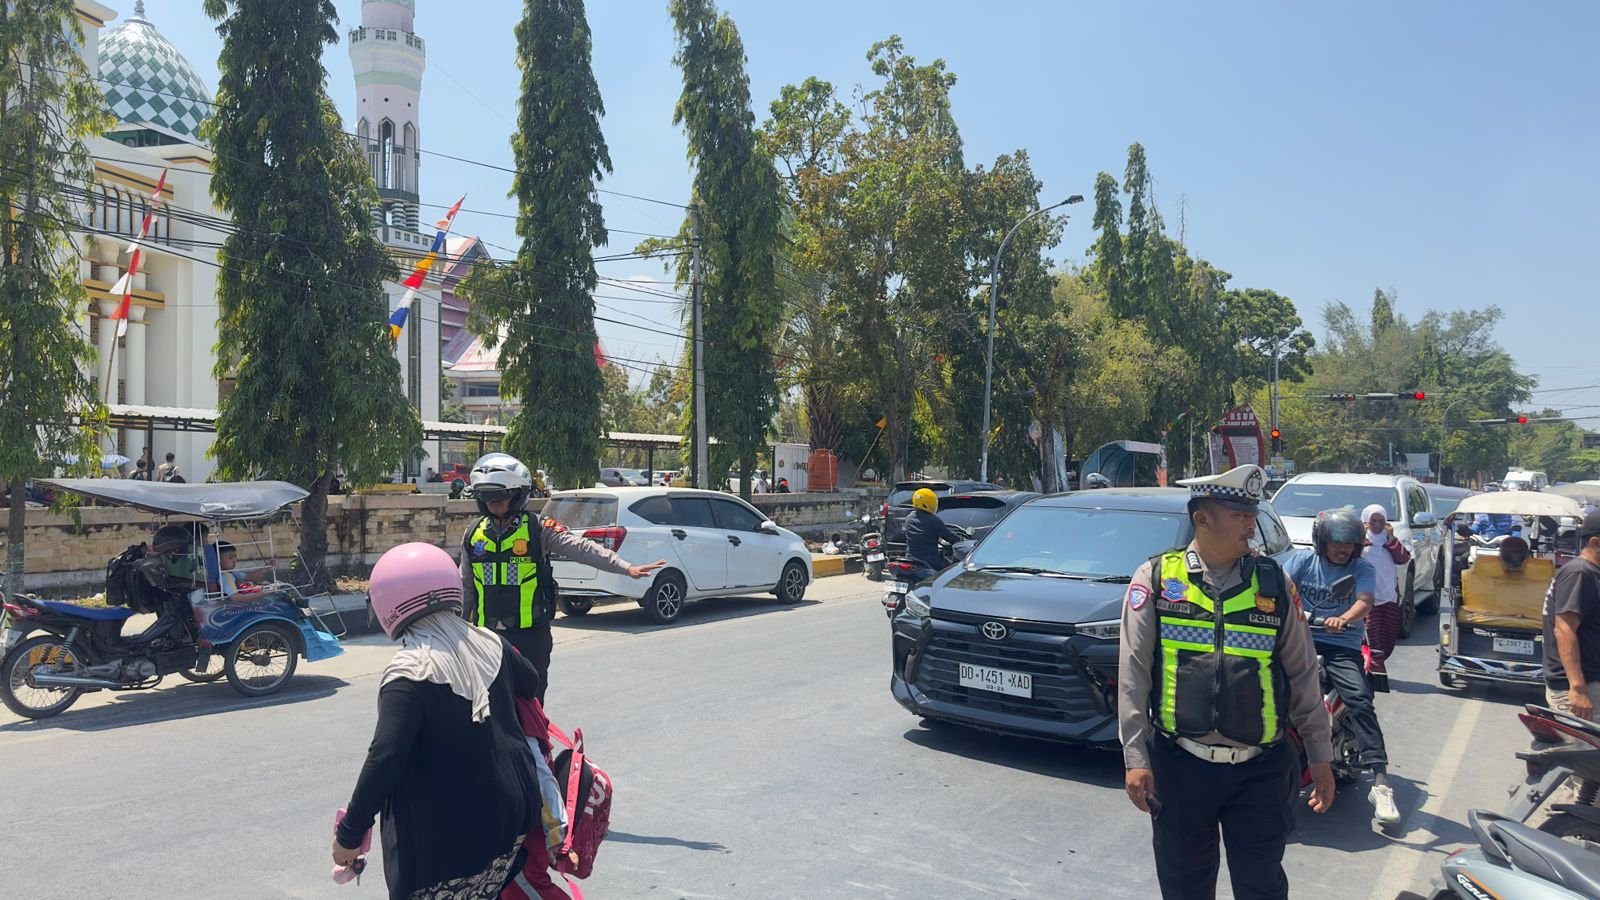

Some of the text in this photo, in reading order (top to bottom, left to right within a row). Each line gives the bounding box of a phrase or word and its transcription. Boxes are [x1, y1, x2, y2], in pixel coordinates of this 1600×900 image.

[961, 665, 1030, 690] DD 1451 XAD
